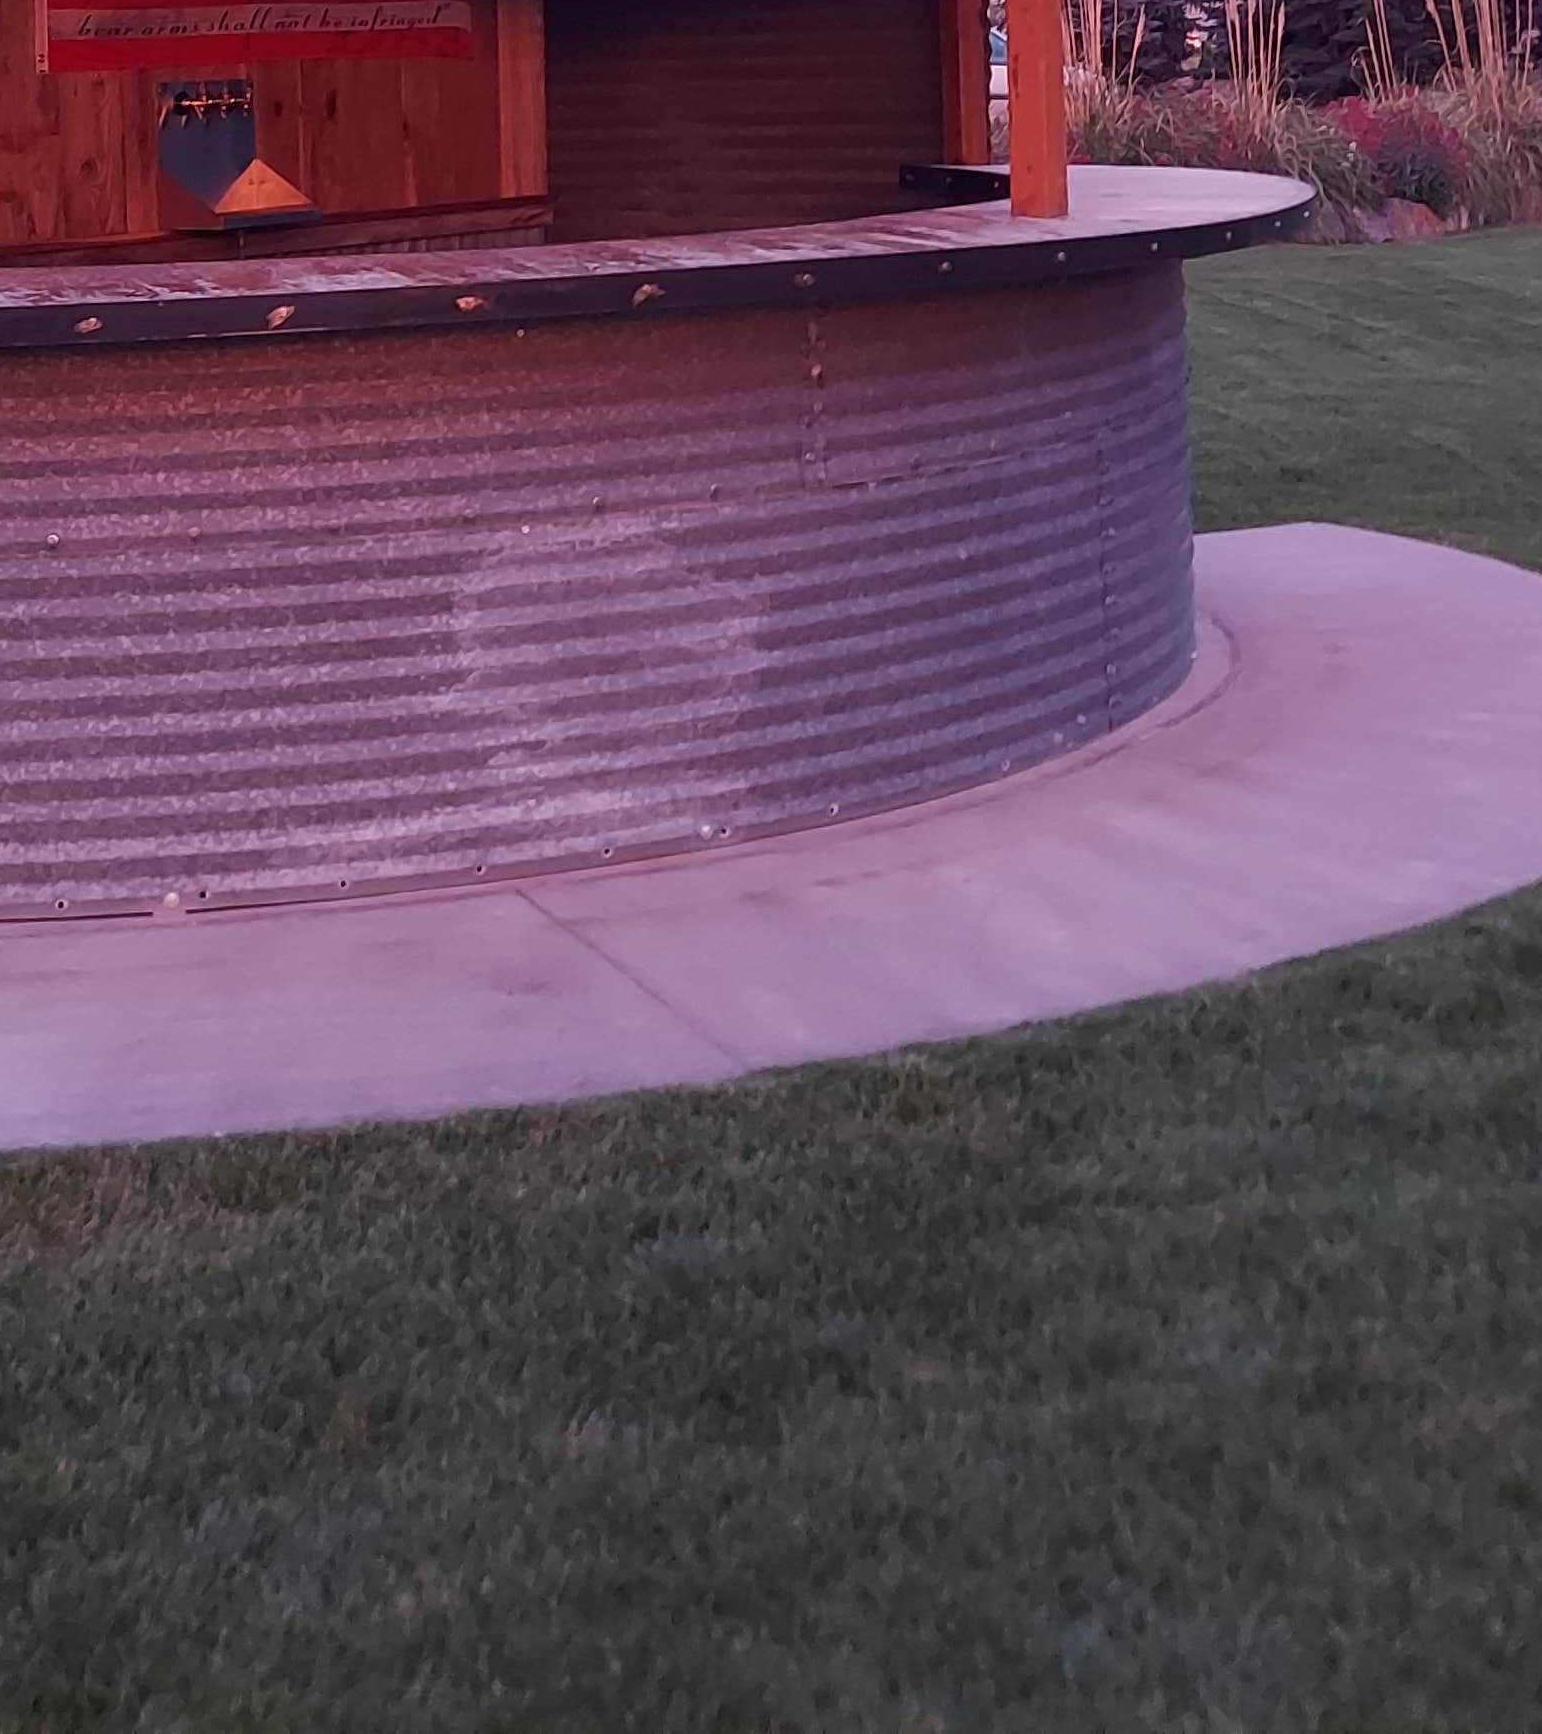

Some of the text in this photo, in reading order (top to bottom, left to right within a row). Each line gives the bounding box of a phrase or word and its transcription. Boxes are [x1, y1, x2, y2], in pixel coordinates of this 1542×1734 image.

[77, 13, 135, 37] bear
[140, 21, 199, 37] arms
[204, 6, 272, 32] shall
[274, 14, 312, 29] not
[318, 7, 343, 28] be
